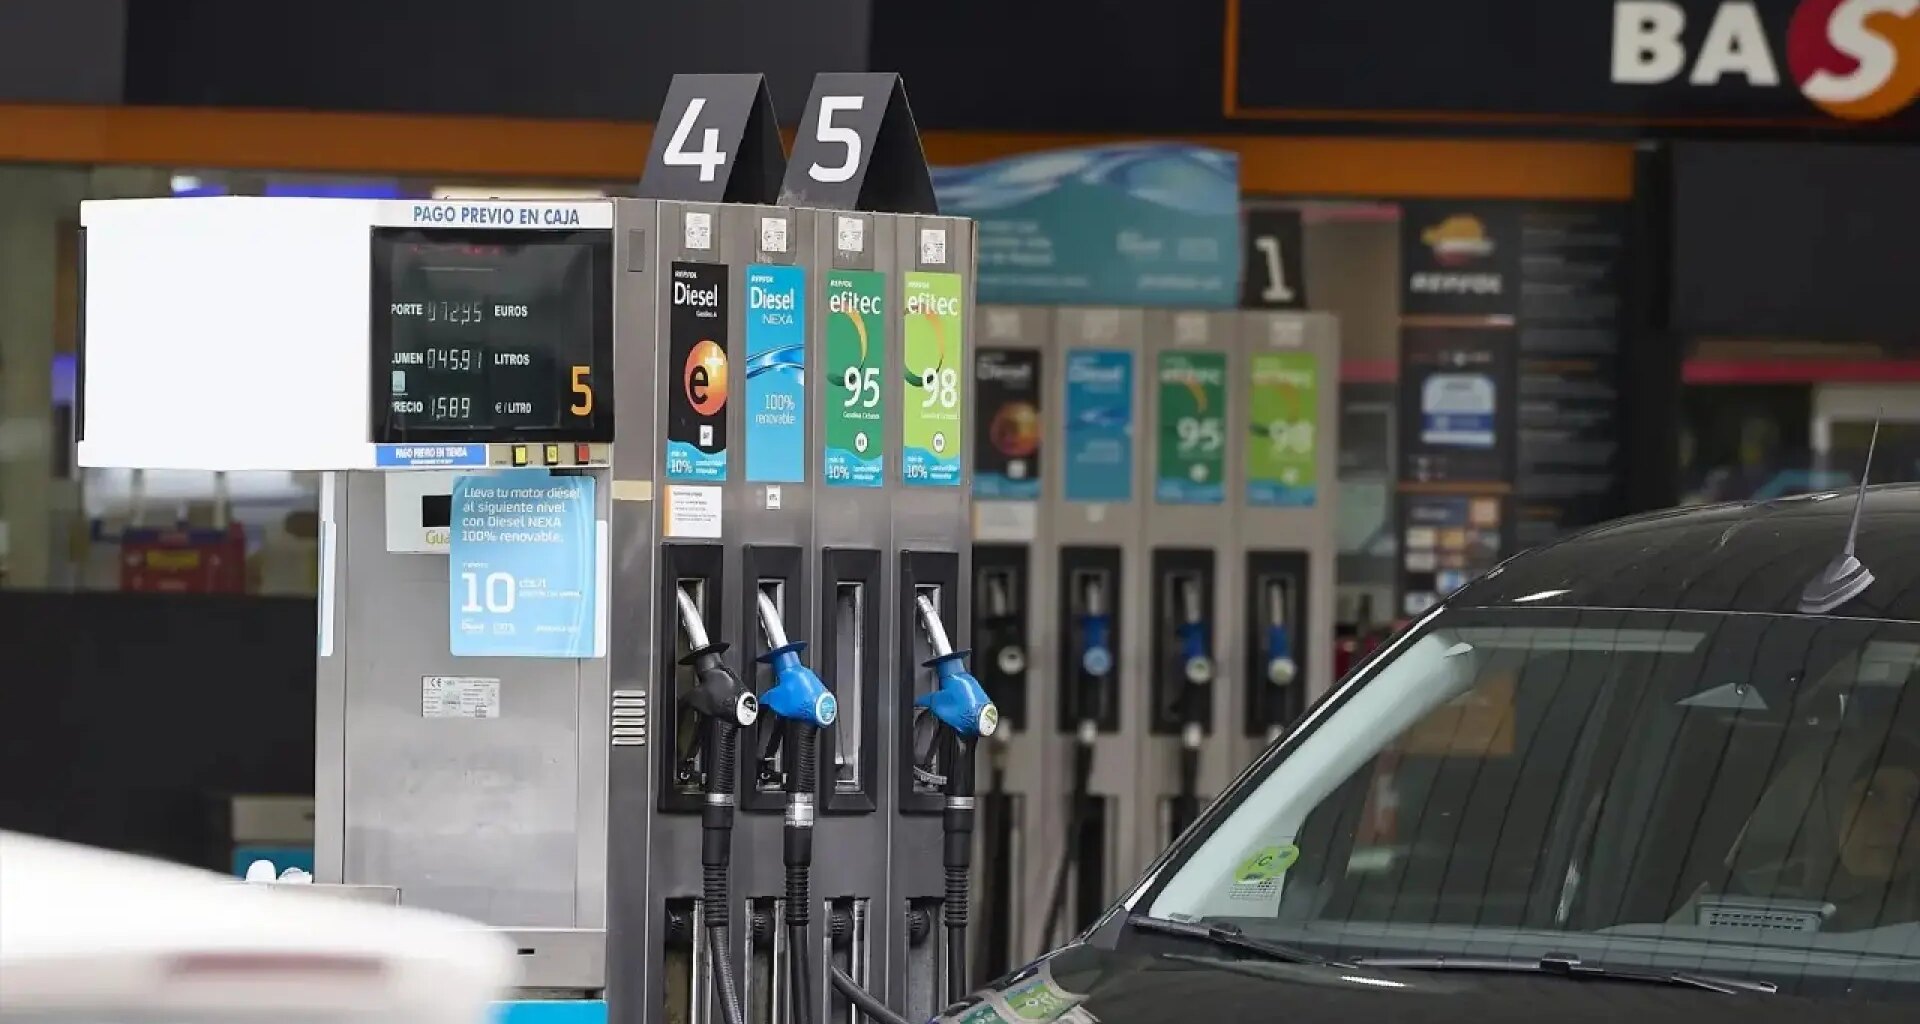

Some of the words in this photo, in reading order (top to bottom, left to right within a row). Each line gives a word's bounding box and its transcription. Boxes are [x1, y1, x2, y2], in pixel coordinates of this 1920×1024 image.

[663, 98, 727, 181] 4
[808, 96, 864, 182] 5
[413, 206, 456, 222] PAGO
[461, 207, 514, 225] PREVIO
[520, 209, 539, 225] EN
[544, 209, 580, 225] CAJA
[1255, 236, 1295, 302] 1
[674, 281, 718, 307] Diesel
[750, 286, 795, 310] Diesel
[830, 291, 881, 315] efitec
[908, 292, 958, 315] efitec
[494, 304, 528, 317] EUROS
[763, 314, 793, 325] NEXA
[391, 352, 423, 364] UMEN
[494, 353, 530, 366] LITROS
[571, 366, 592, 416] 5
[844, 366, 880, 408] 95
[922, 367, 957, 408] 98
[431, 397, 471, 420] 1,589
[764, 394, 795, 411] 100%
[755, 412, 796, 425] renovable
[1177, 416, 1223, 452] 95
[396, 448, 413, 459] PAGO
[414, 448, 436, 458] PREVIO
[437, 448, 445, 458] EN
[671, 459, 693, 474] 10%
[829, 464, 850, 480] 10%
[907, 464, 928, 479] 10%
[464, 487, 494, 498] Lleva
[497, 488, 508, 498] tu
[511, 488, 544, 498] motor
[463, 502, 474, 513] al
[478, 502, 533, 515] siguiente
[536, 501, 566, 513] nivel
[462, 518, 484, 527] con
[488, 516, 524, 528] Diesel
[528, 517, 561, 528] NEXA
[462, 531, 496, 541] 100%
[462, 572, 515, 613] 10
